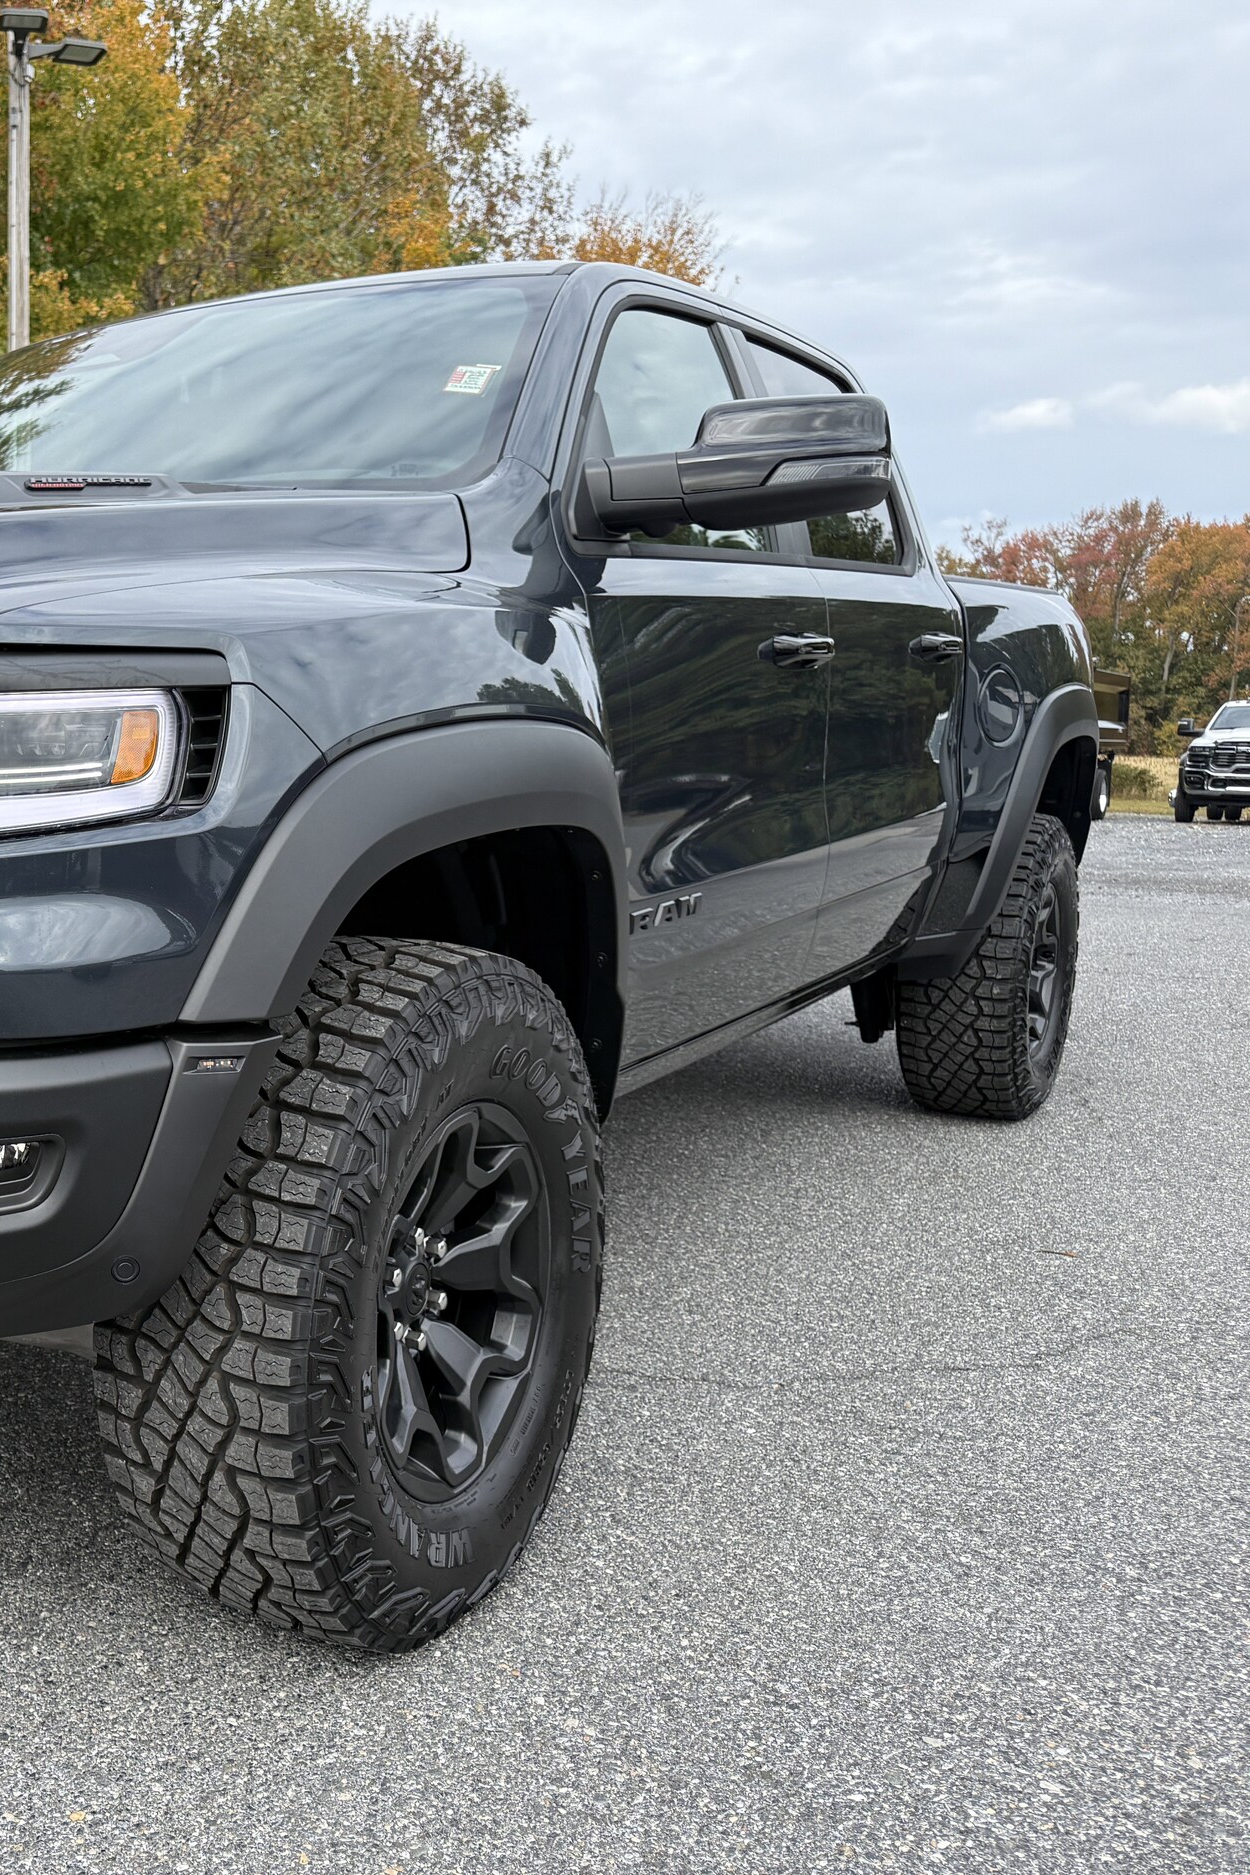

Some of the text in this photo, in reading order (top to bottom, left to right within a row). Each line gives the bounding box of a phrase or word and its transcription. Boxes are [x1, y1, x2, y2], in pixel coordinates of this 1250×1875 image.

[29, 476, 152, 484] HURRICANE
[628, 892, 703, 935] RAM
[490, 1044, 591, 1274] GOODYEAR
